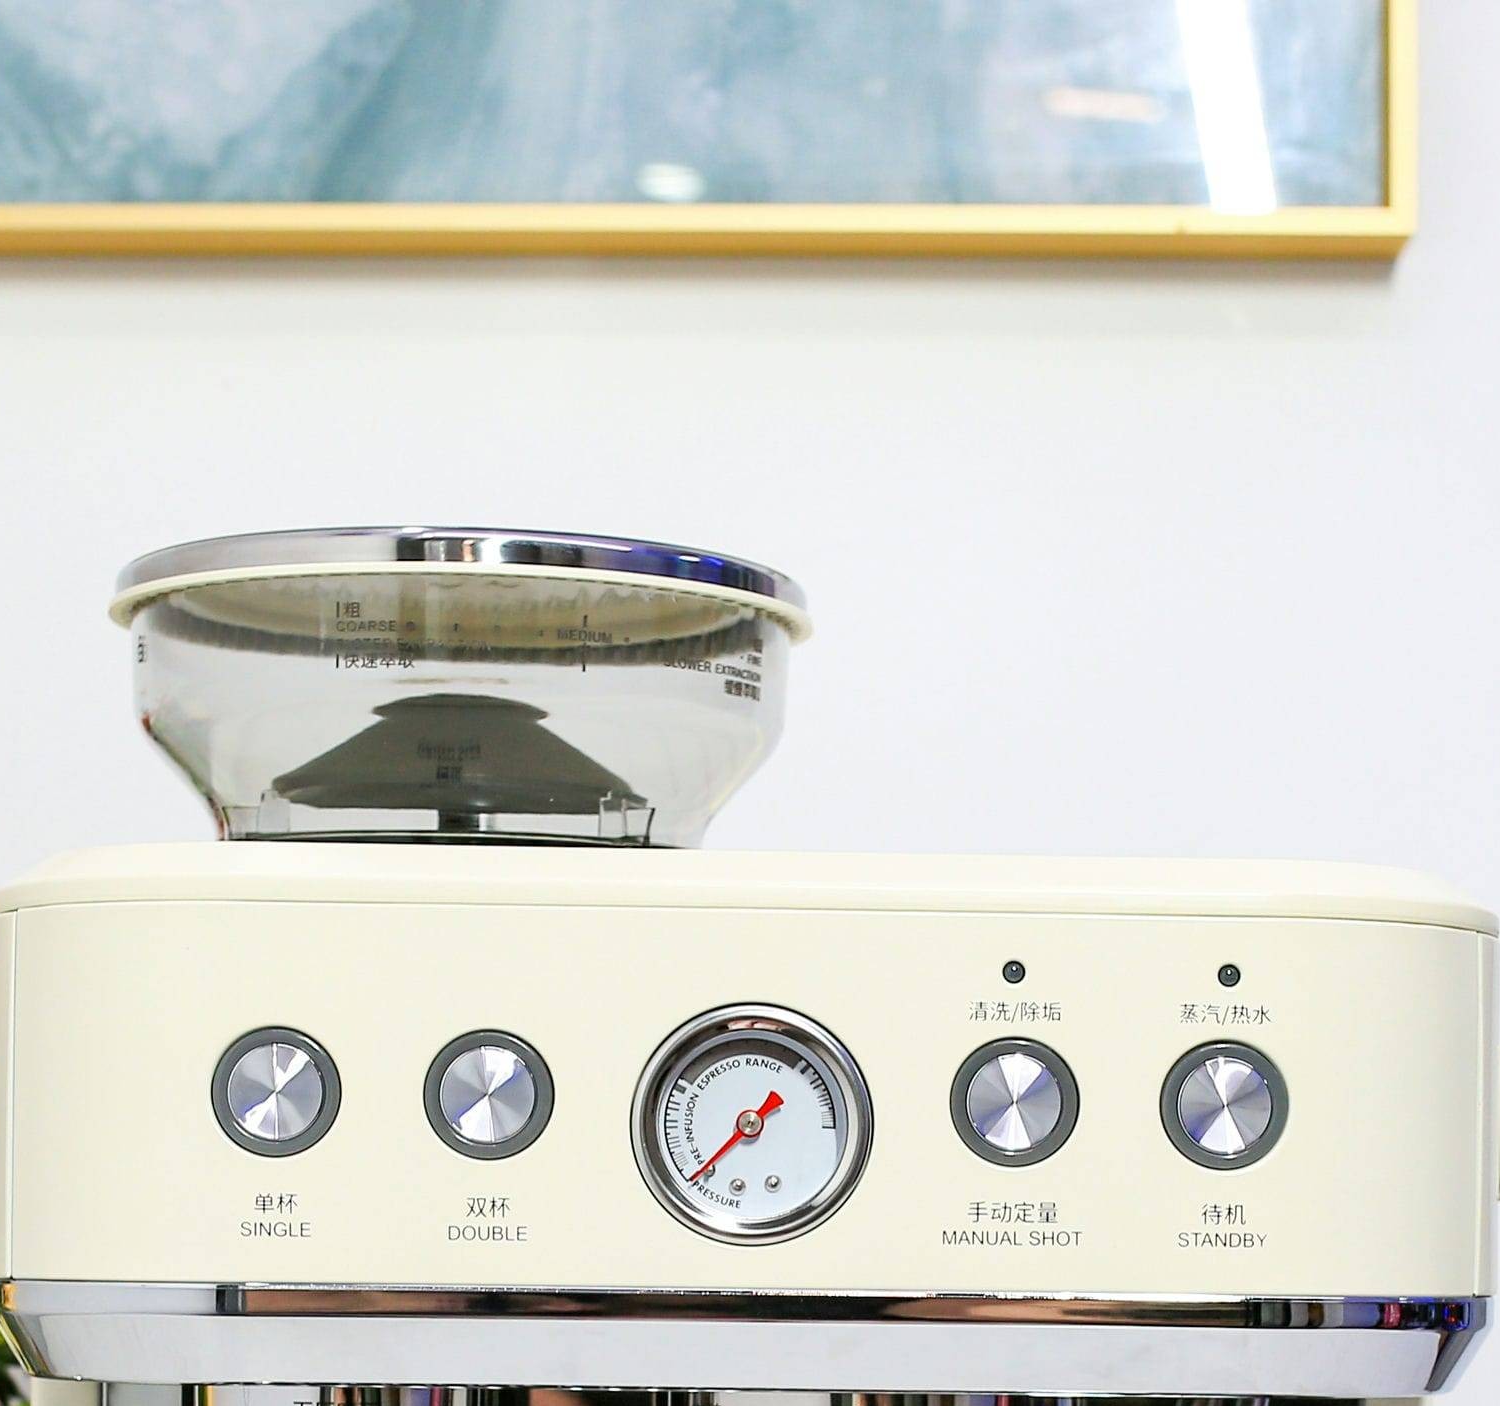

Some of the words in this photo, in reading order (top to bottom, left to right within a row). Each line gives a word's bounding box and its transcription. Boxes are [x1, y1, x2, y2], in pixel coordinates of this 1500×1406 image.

[336, 620, 398, 632] COARSE
[557, 629, 613, 643] MEDIUM
[968, 1001, 1062, 1023] 清洗/除垢
[1179, 1003, 1272, 1025] 蒸汽/热水
[697, 1059, 741, 1091] ESPRESSO
[745, 1057, 783, 1074] RANGE
[684, 1093, 705, 1166] PRE-INFUSION
[254, 1193, 299, 1214] 单杯
[692, 1180, 742, 1209] PRESSURE
[466, 1196, 511, 1218] 双杯
[967, 1201, 1058, 1223] 手动定量
[1201, 1203, 1246, 1225] 待机
[240, 1221, 312, 1238] SINGLE
[448, 1225, 529, 1242] DOUBLE
[942, 1230, 1023, 1247] MANUAL
[1029, 1230, 1083, 1247] SHOT
[1178, 1231, 1269, 1248] STANDBY
